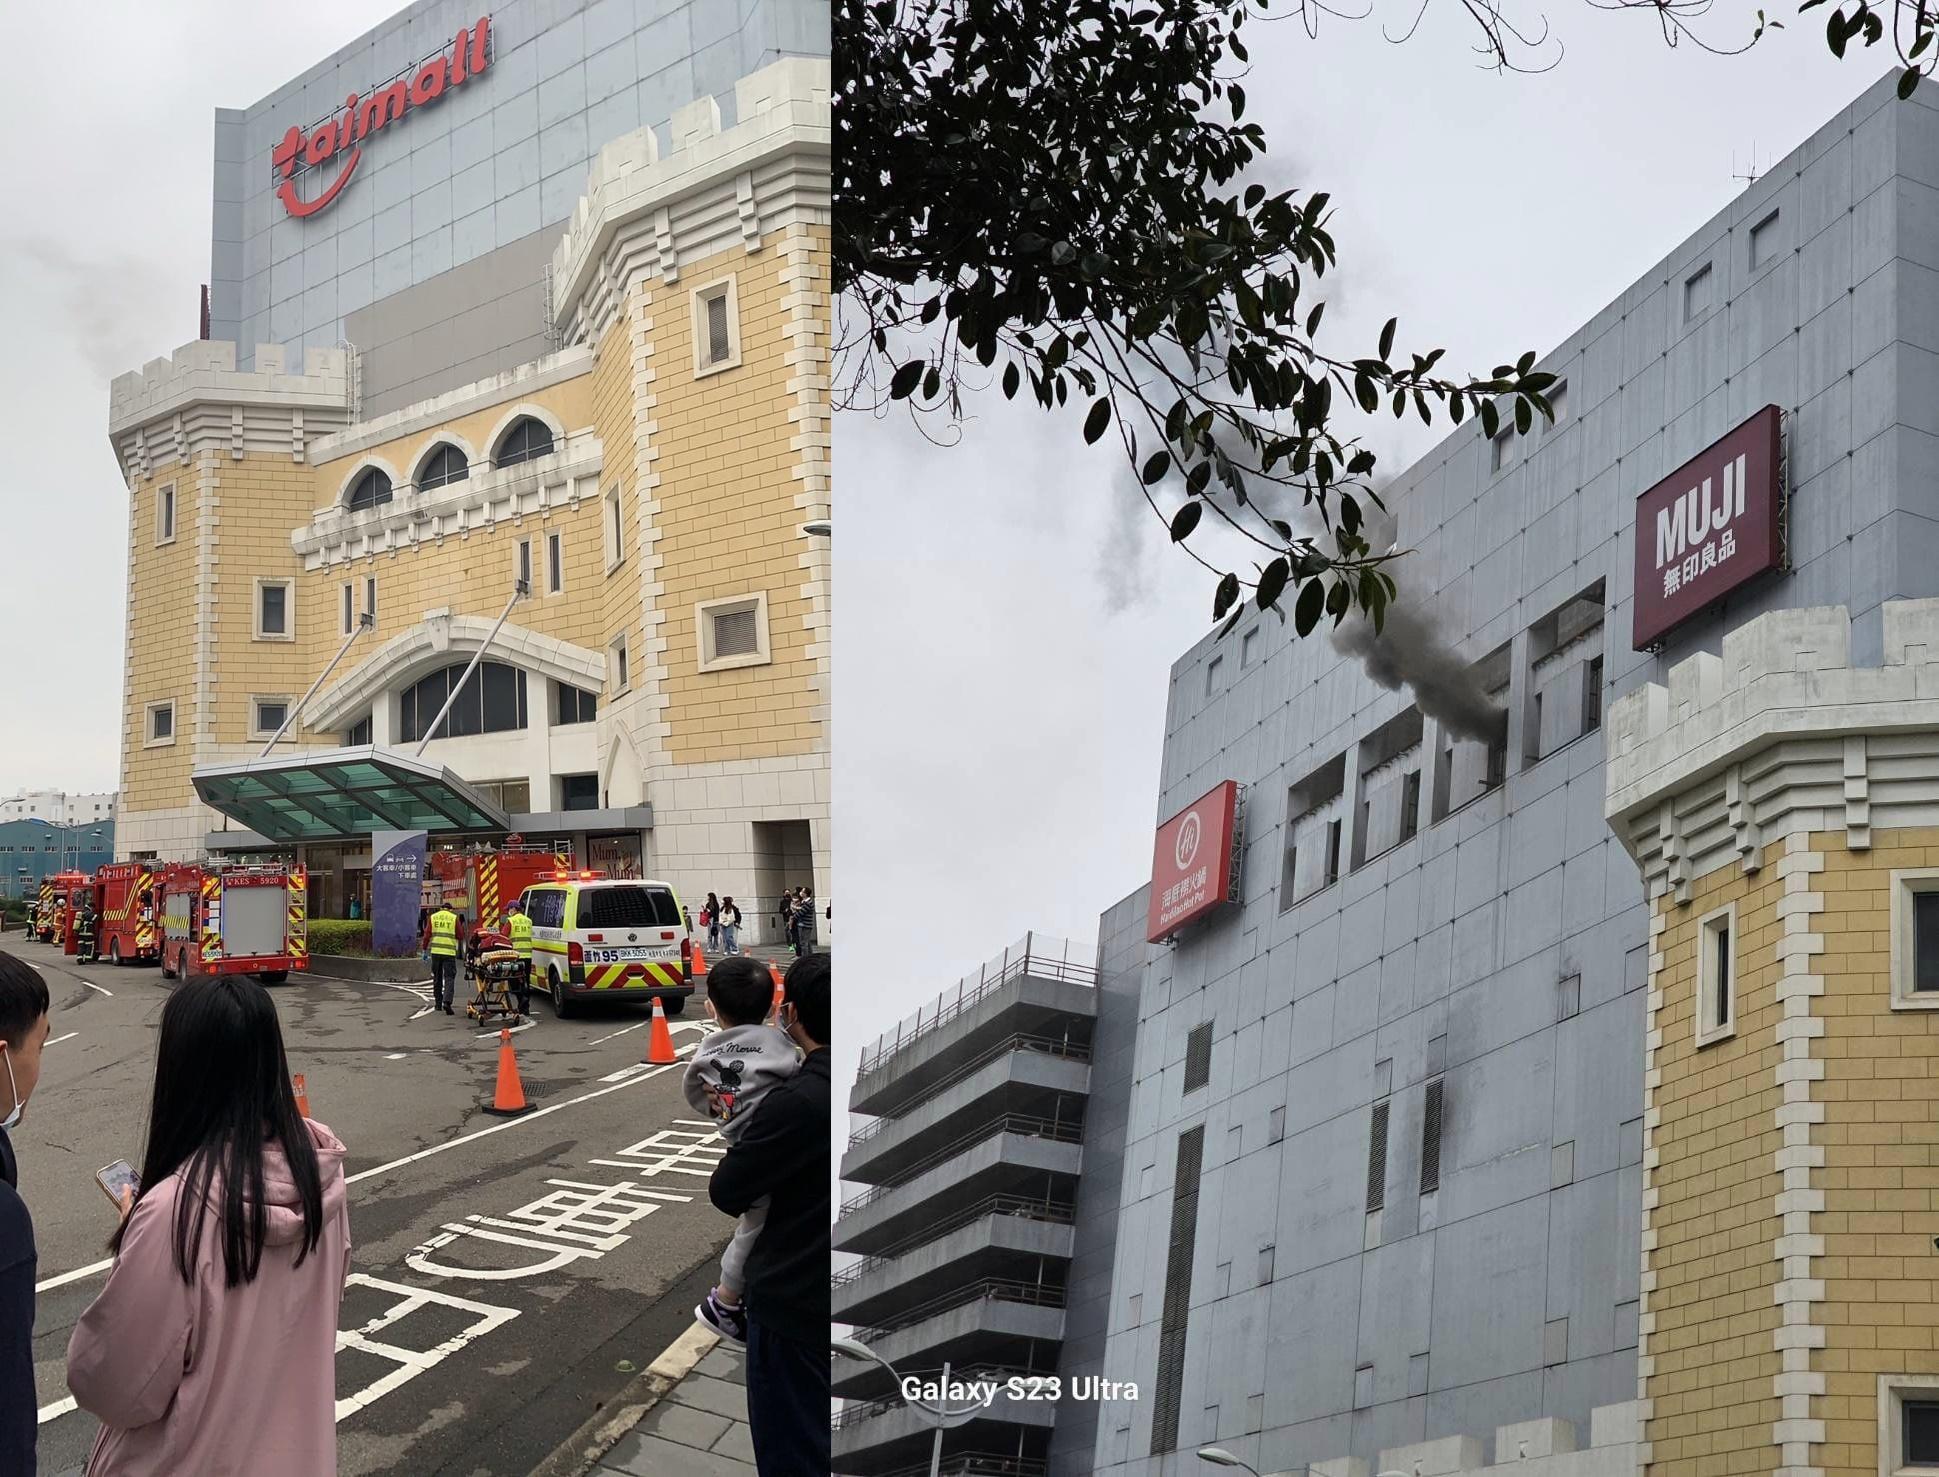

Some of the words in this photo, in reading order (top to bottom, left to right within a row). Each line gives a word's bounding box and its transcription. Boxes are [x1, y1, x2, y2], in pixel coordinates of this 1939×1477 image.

[272, 16, 490, 178] taimall
[1656, 453, 1746, 570] MUJI
[1663, 528, 1736, 599] 無印良品
[260, 877, 279, 885] 5920
[434, 921, 451, 929] EMT
[601, 950, 619, 962] 95
